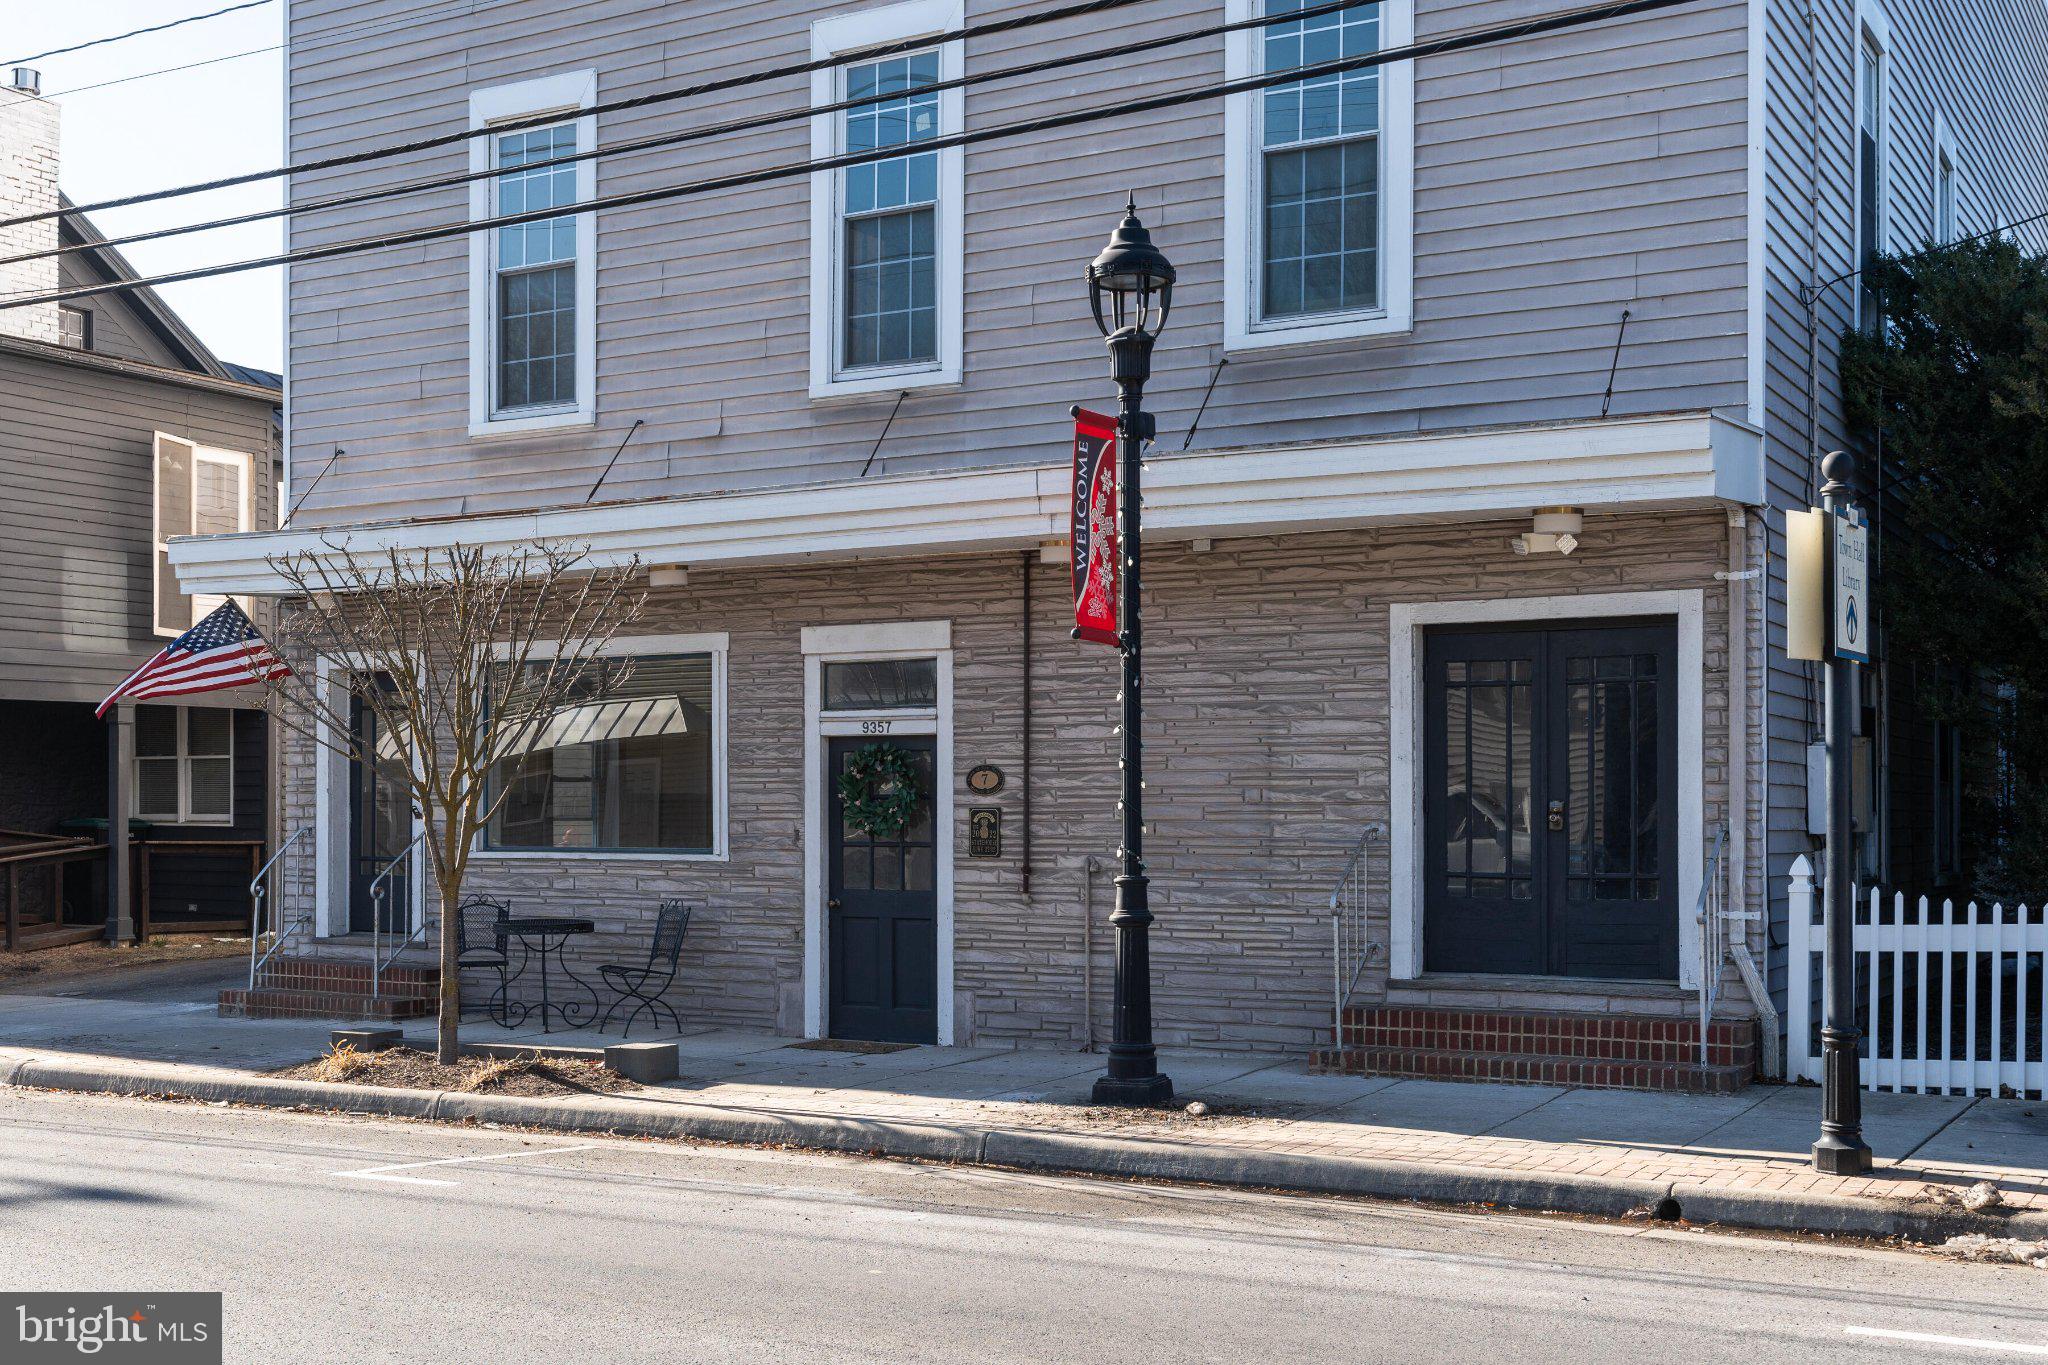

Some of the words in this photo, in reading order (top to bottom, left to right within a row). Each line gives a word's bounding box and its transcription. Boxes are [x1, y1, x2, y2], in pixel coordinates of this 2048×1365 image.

[1076, 440, 1089, 571] WELCOME
[1839, 534, 1851, 558] Town
[1853, 540, 1865, 563] Hall
[1842, 566, 1861, 596] Library
[862, 721, 892, 734] 9357
[981, 773, 989, 786] 7
